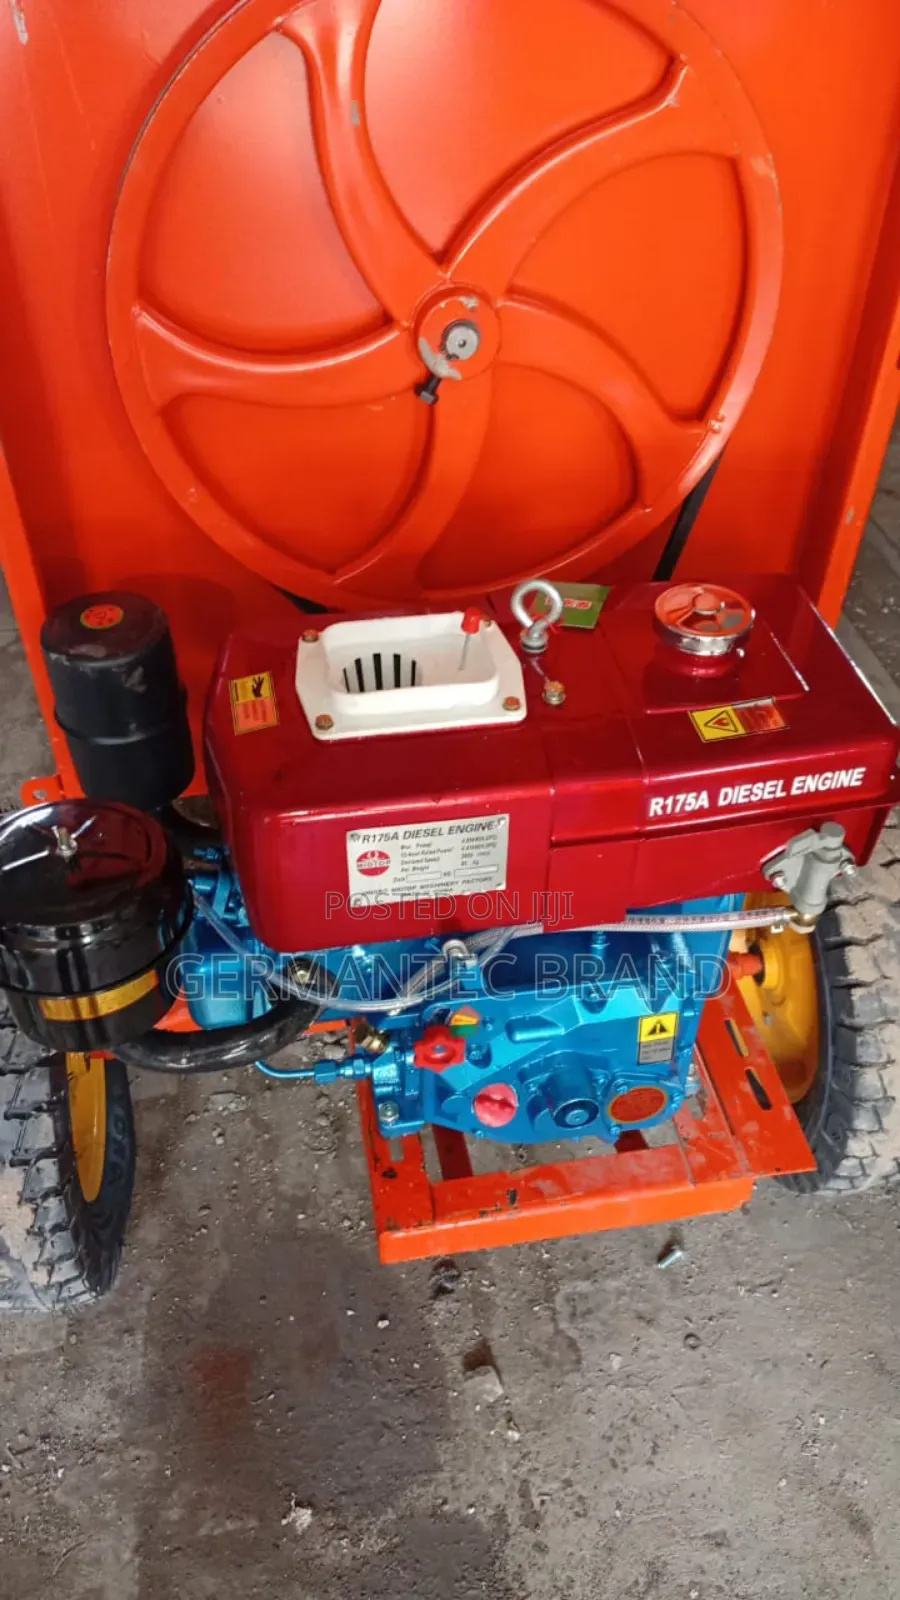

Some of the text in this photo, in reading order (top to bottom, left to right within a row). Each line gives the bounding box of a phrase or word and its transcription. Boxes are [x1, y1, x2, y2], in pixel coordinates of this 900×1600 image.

[649, 767, 866, 817] R175A DIESEL ENGINE
[362, 831, 399, 844] R175A
[402, 827, 445, 840] DIESEL
[448, 820, 493, 834] ENGINE
